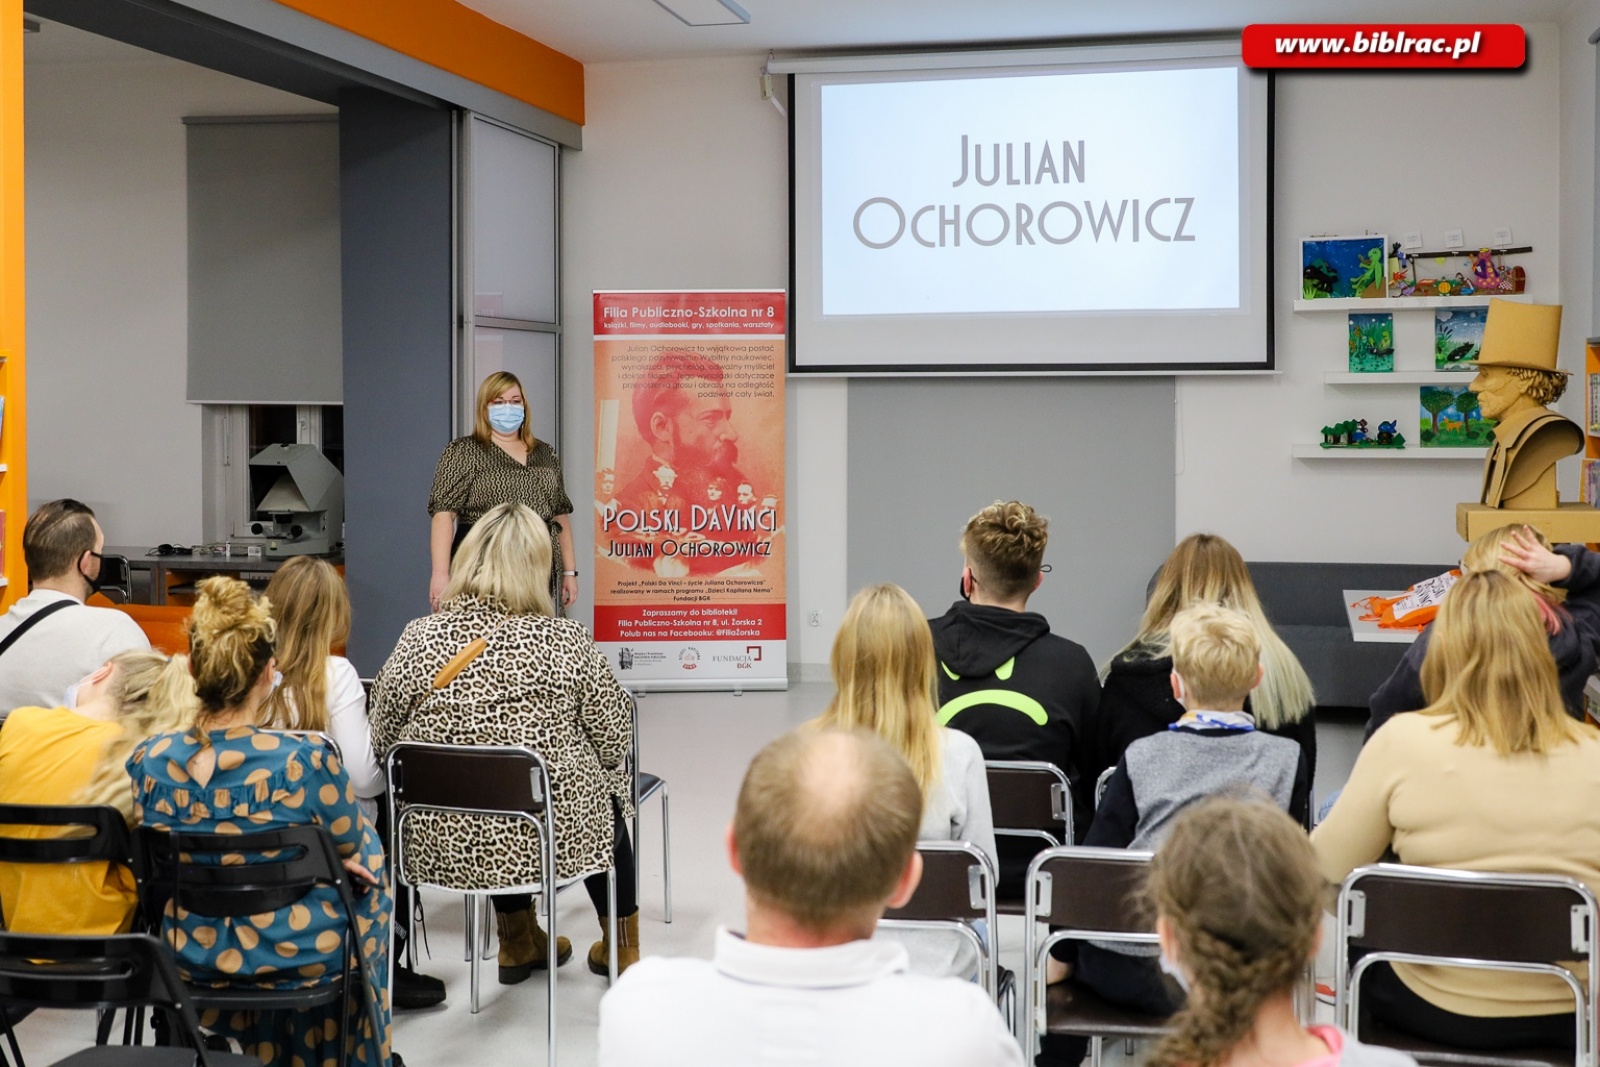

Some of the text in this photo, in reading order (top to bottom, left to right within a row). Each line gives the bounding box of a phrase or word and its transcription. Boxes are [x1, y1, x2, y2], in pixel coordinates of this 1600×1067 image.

[952, 134, 1085, 188] JULIAN
[853, 196, 1196, 249] OCHOROWICZ
[603, 306, 775, 318] Filia Publiczno-Szkolna nr 8
[630, 321, 648, 329] filmy,
[748, 345, 774, 353] postać
[700, 354, 729, 362] Wybitny
[603, 505, 680, 532] POLSKI
[607, 539, 772, 558] JULIAN OCHOROWICZ
[642, 609, 687, 617] Zapraszamy
[634, 619, 701, 627] Publiczno-Szkolna
[731, 618, 756, 626] Żorska
[757, 618, 763, 626] 2
[716, 628, 760, 636] @FiliaŻorska
